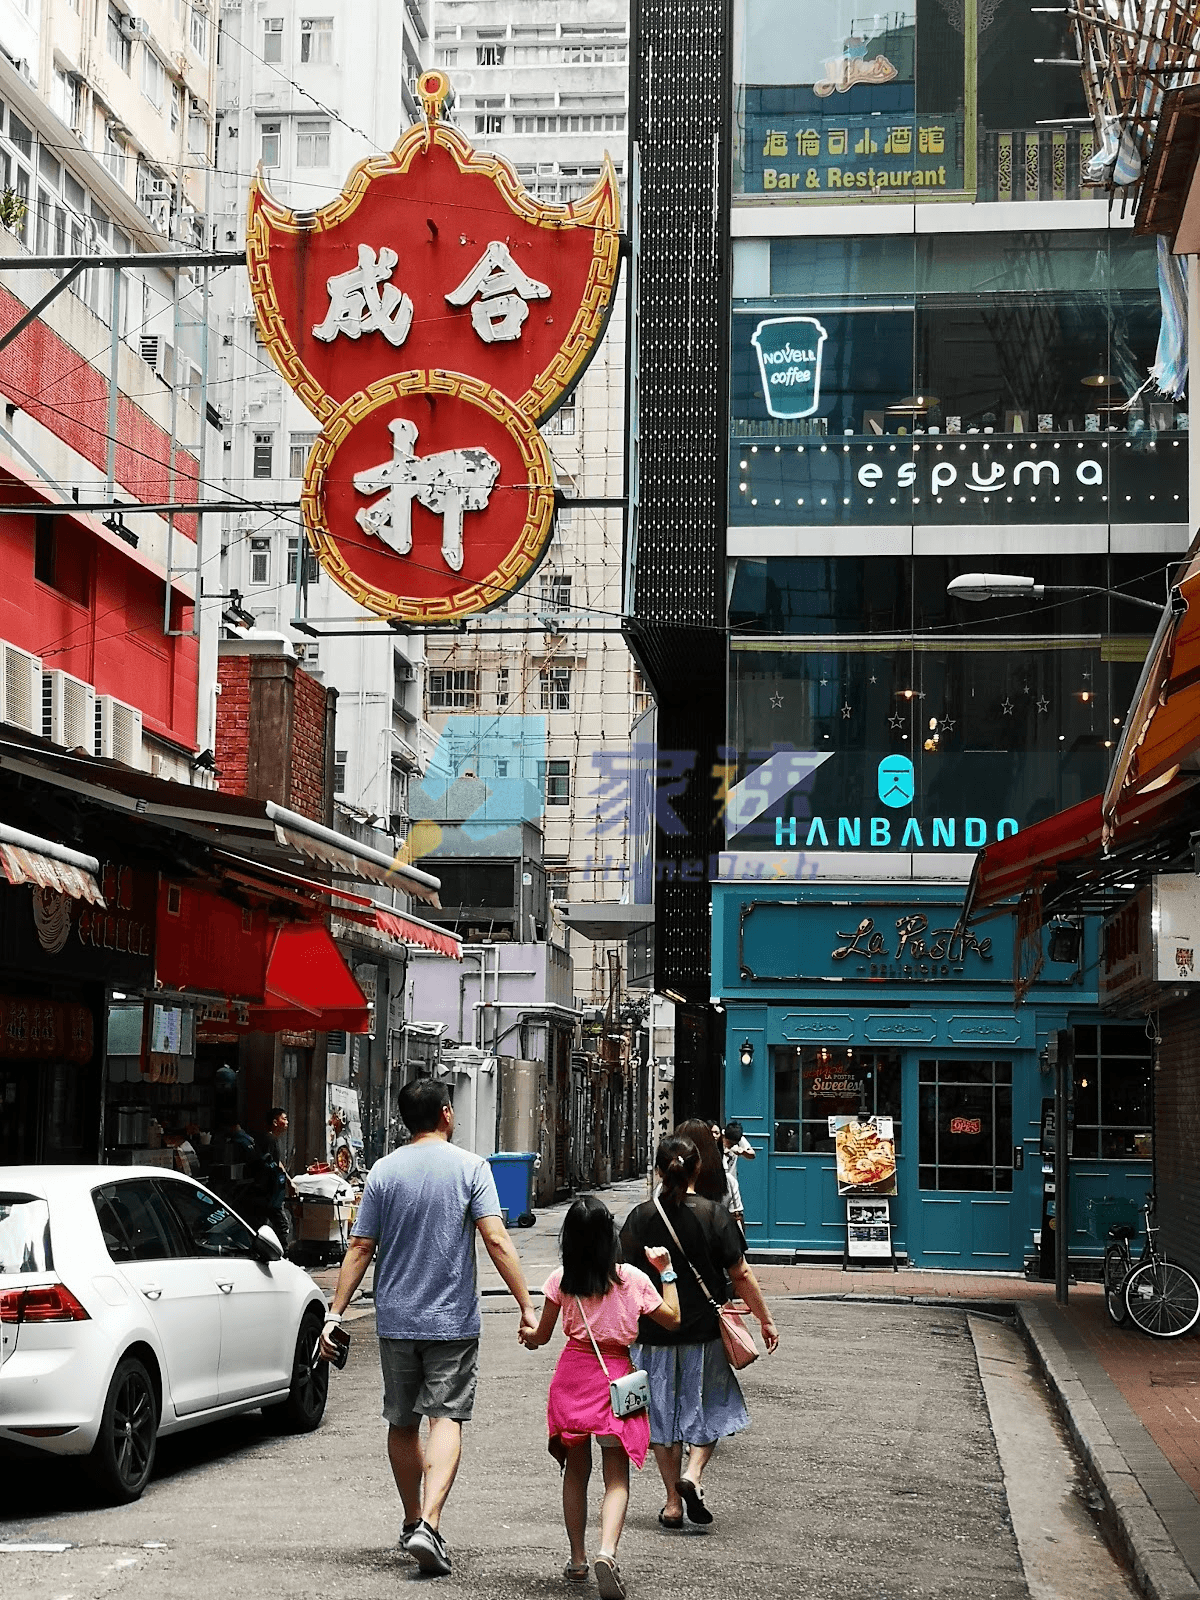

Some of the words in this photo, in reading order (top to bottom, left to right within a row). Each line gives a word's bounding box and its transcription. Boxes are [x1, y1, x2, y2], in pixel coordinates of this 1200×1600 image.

[762, 125, 946, 156] 海倫司小酒館
[763, 168, 800, 189] Bar
[805, 168, 821, 188] &
[827, 166, 946, 188] Restaurant
[770, 366, 811, 386] coffee
[858, 459, 1103, 496] espuma
[353, 418, 500, 572] 押
[775, 816, 1019, 847] HANBANDO
[831, 917, 889, 960] La
